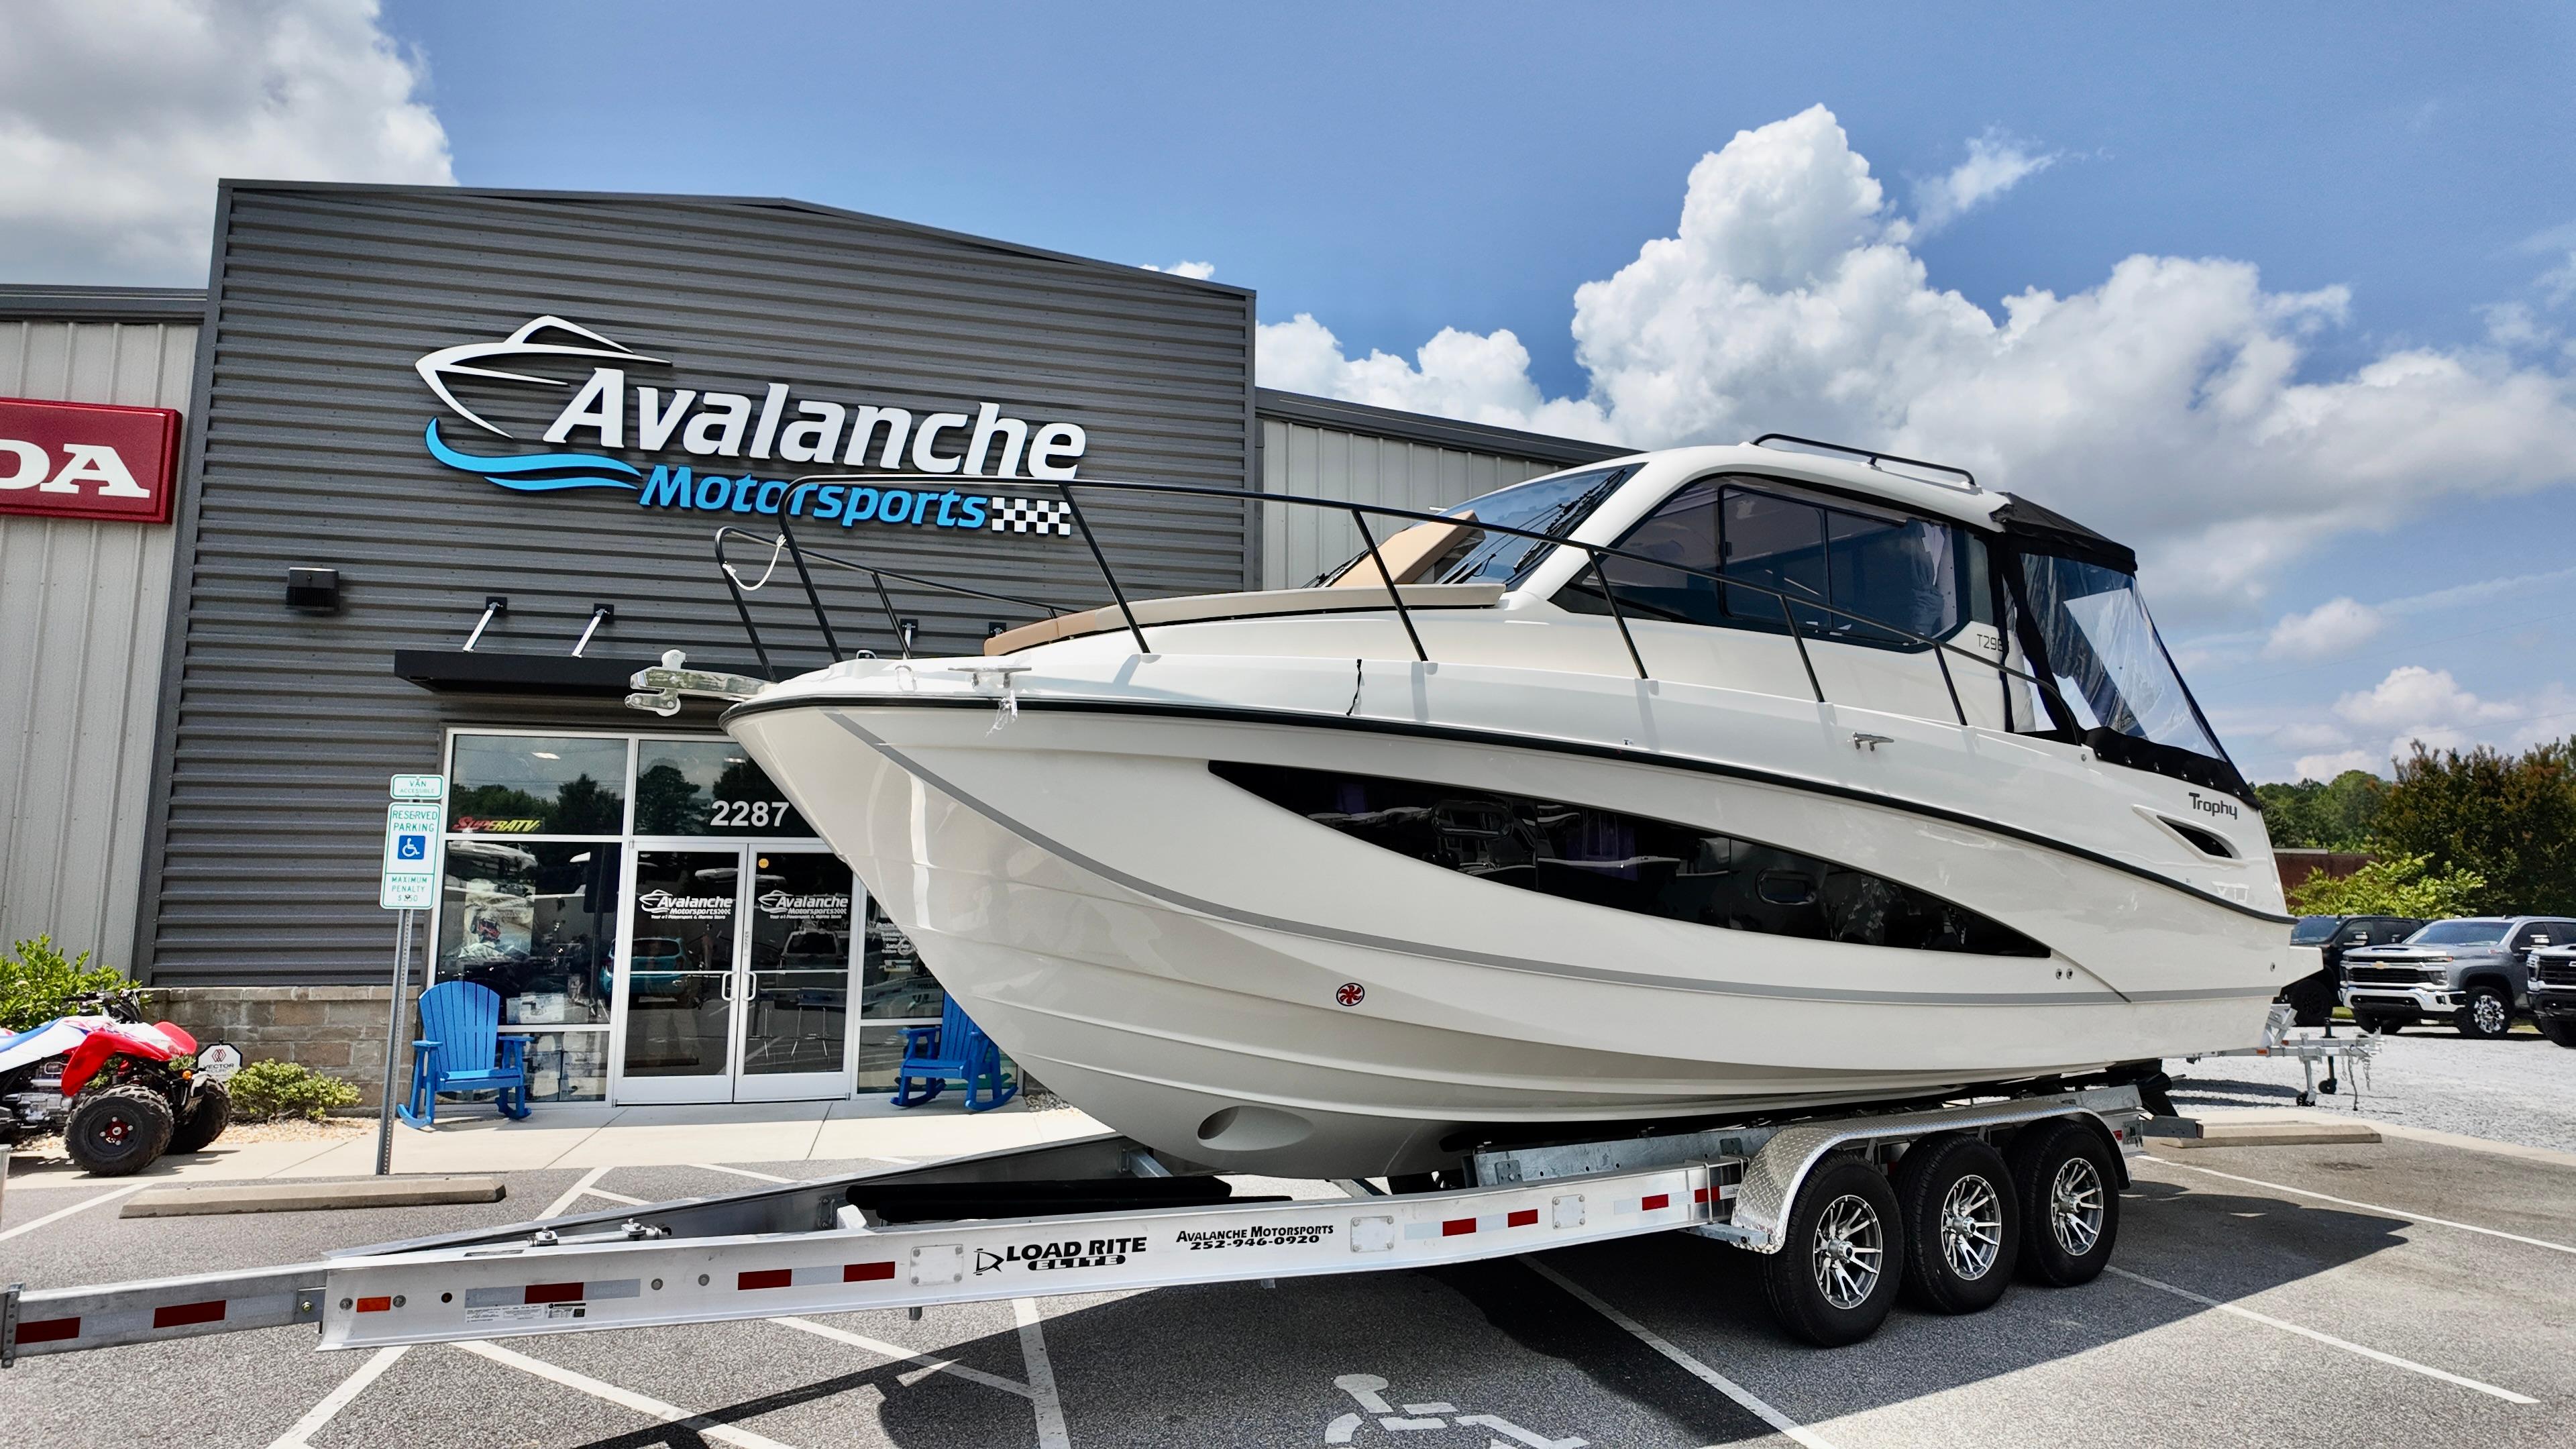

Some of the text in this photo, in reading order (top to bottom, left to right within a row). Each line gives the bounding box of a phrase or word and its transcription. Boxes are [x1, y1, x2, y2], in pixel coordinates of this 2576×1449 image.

[542, 367, 1087, 480] Avalanche
[639, 464, 988, 529] Motorsports
[409, 780, 427, 788] VAN
[710, 800, 790, 827] 2287
[2188, 792, 2238, 820] Trophy
[392, 810, 438, 820] RESERVED
[394, 822, 435, 833] PARKING
[392, 885, 425, 893] PENALTY
[657, 896, 733, 908] Avalanche
[775, 895, 849, 908] Avalanche
[788, 907, 835, 915] Motorsports
[1176, 1225, 1334, 1242] AVALANCHE MOTORSPORTS
[1006, 1236, 1147, 1262] LOAD RITE
[1190, 1235, 1320, 1250] 252-946-0920
[1035, 1255, 1118, 1271] ELITE
